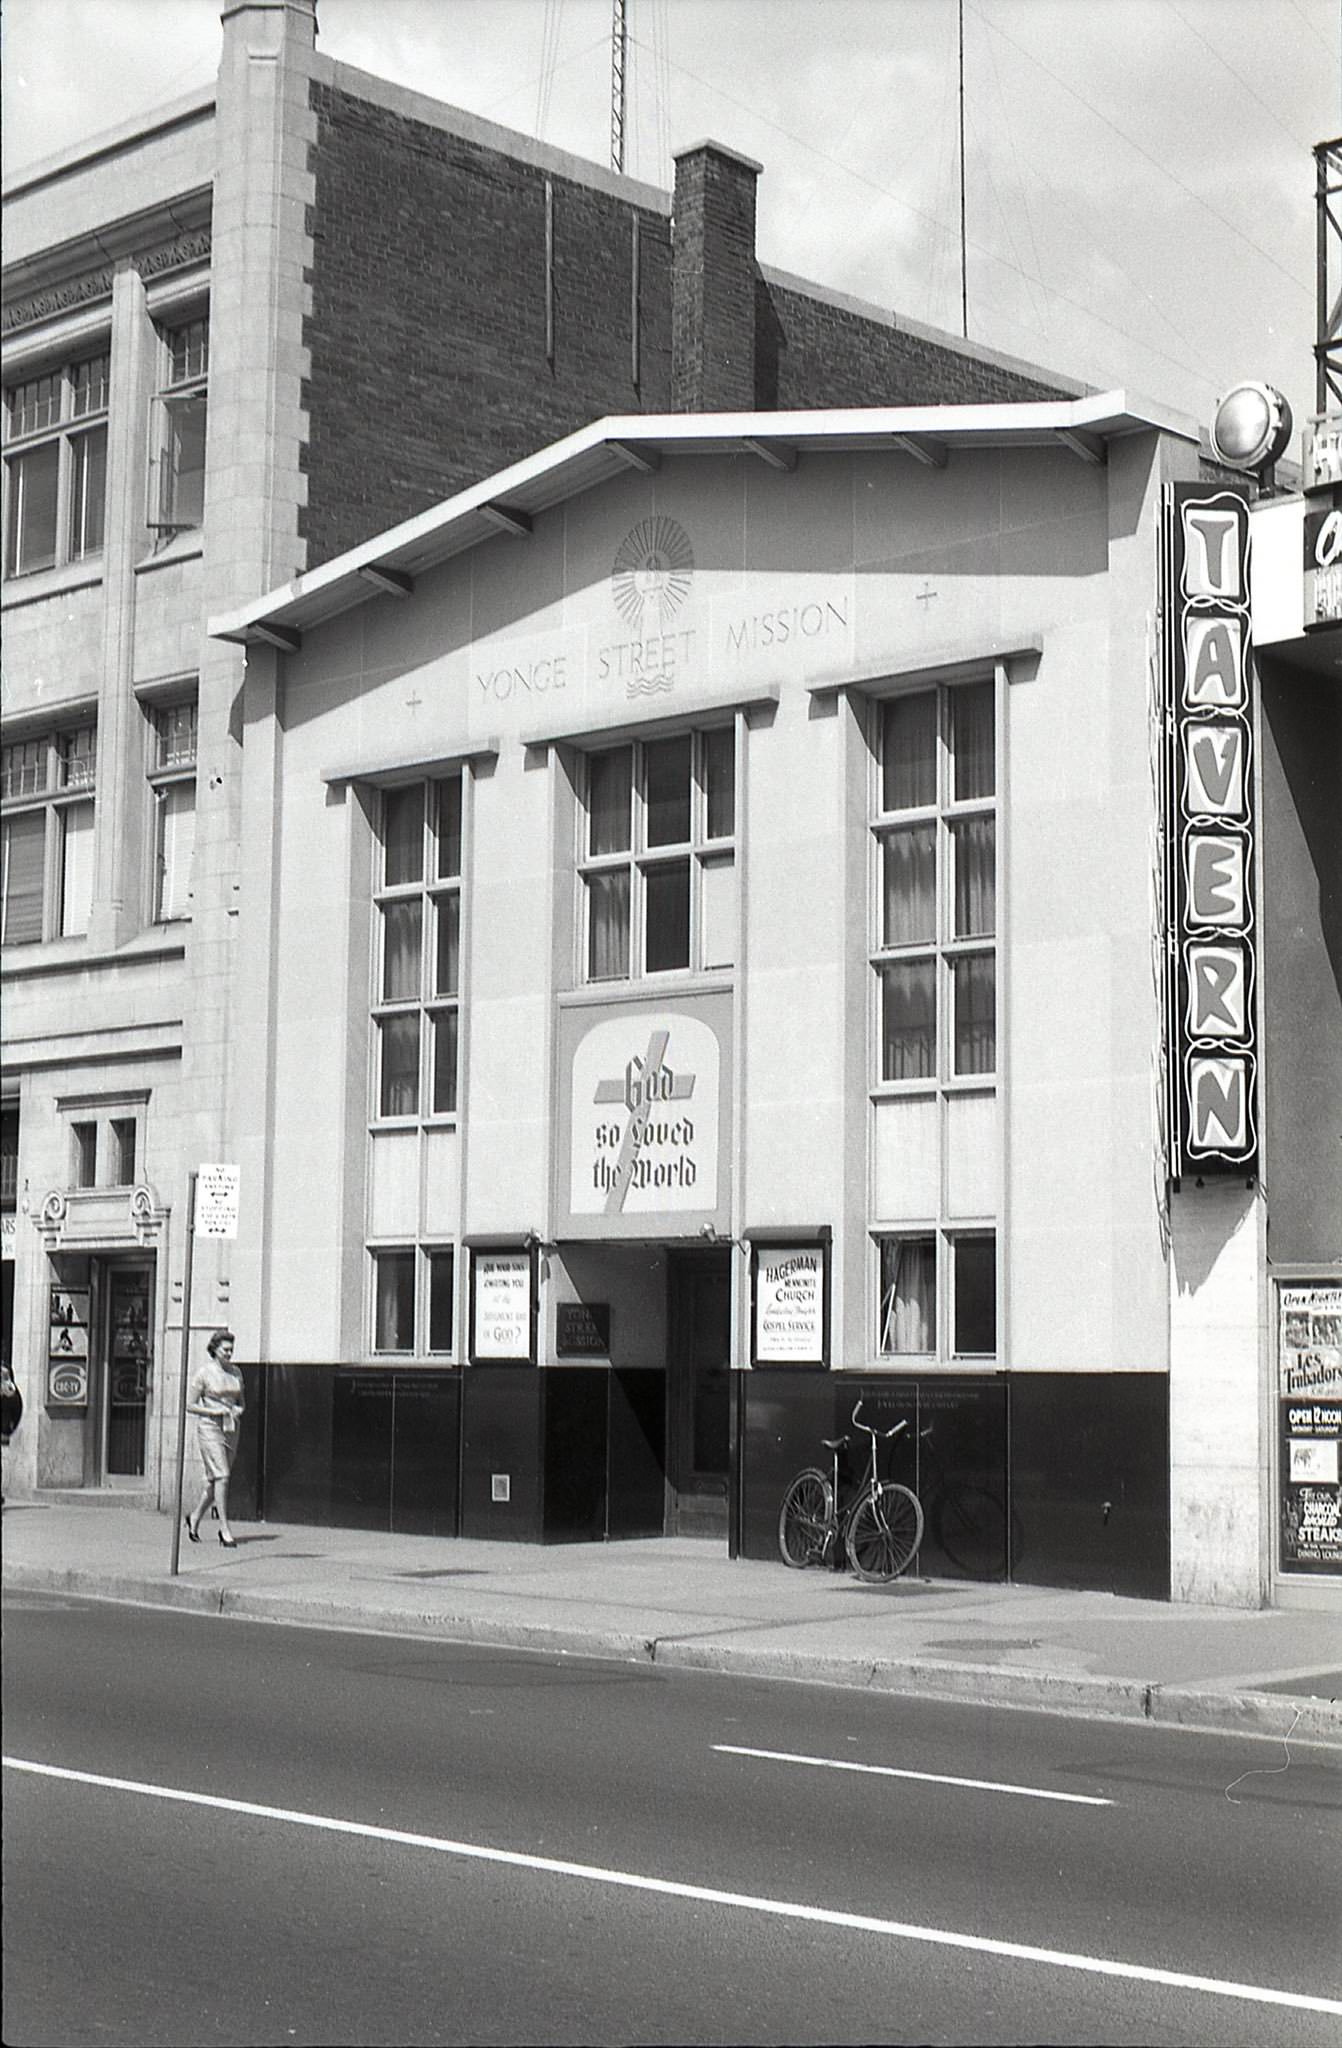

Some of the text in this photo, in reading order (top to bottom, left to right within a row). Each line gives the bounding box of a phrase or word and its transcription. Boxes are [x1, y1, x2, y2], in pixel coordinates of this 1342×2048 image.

[477, 597, 849, 702] YONGE STREET MISSION
[1190, 518, 1242, 1144] TAVERN
[625, 1055, 674, 1113] God
[596, 1124, 620, 1148] so
[593, 1154, 696, 1193] the World
[766, 1256, 817, 1284] HAGERMAN
[1289, 1408, 1312, 1425] OPEN
[1321, 1408, 1341, 1425] NOON
